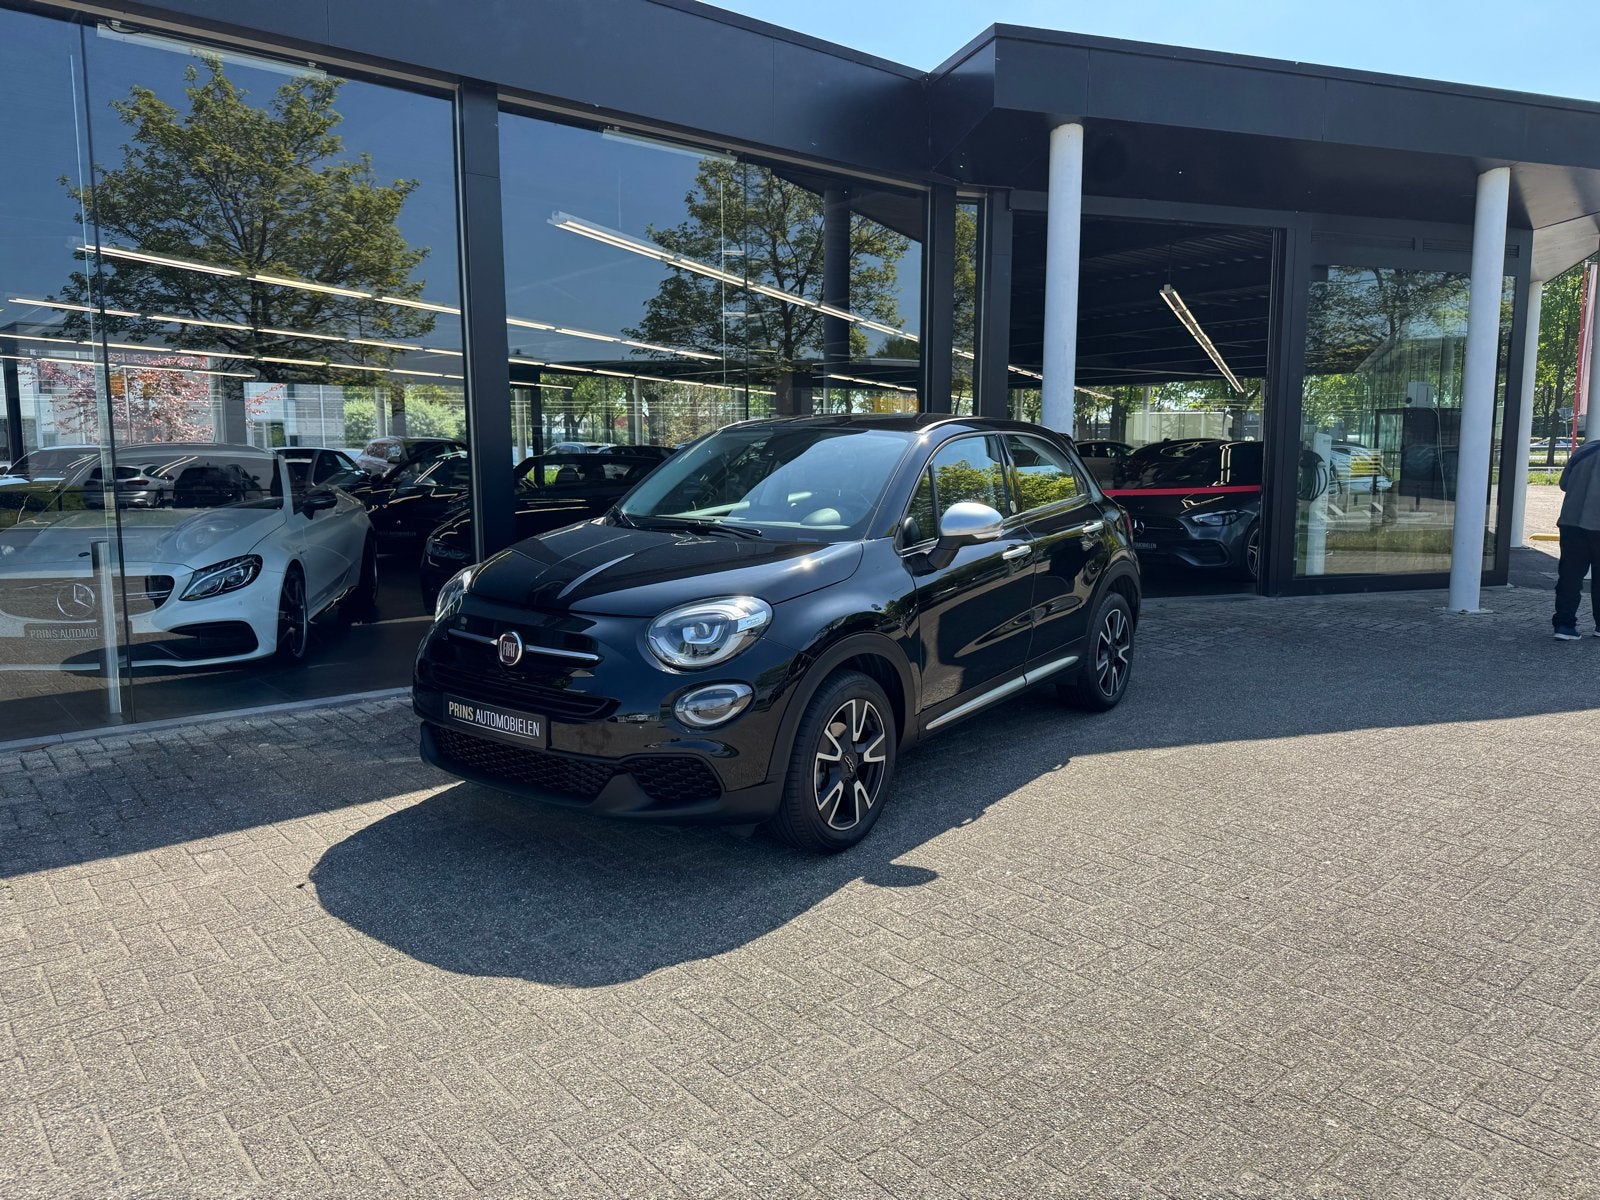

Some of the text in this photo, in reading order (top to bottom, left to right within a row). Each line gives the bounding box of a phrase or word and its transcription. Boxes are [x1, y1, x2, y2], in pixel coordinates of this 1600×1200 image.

[30, 629, 58, 639] PRINS
[503, 641, 517, 658] FIAT
[448, 701, 540, 737] PRINS AUTOMOBIELEN
